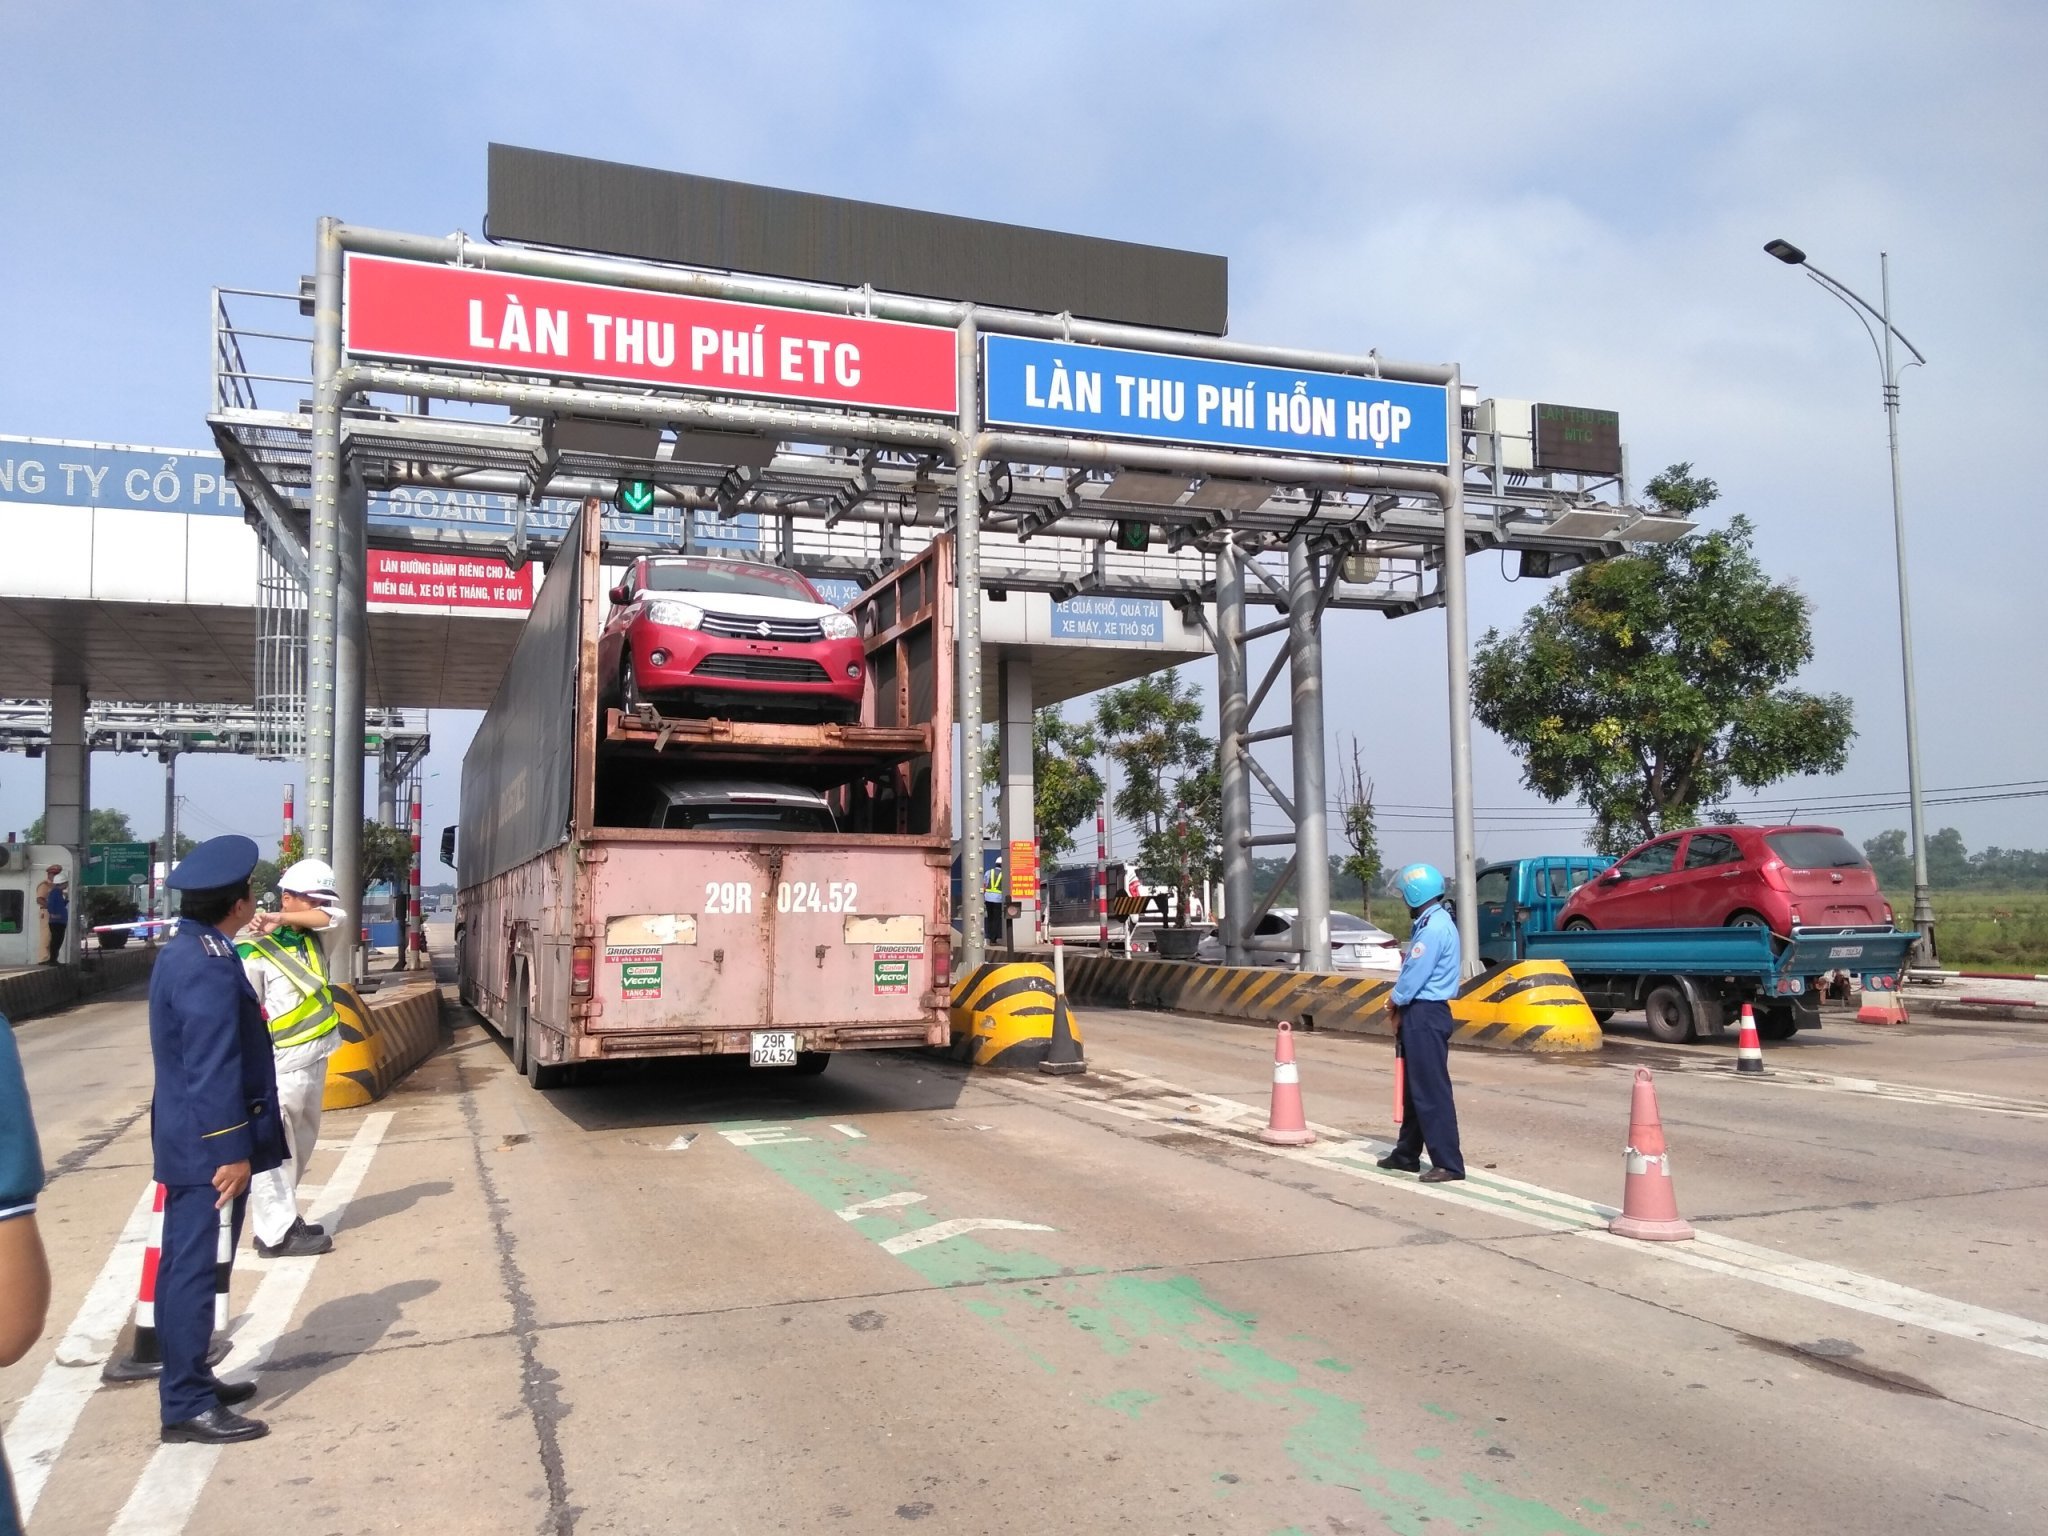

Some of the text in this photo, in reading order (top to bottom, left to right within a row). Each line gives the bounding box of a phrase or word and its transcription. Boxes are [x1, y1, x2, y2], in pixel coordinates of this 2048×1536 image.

[469, 294, 861, 388] LÀN THU PHÍ ETC
[1025, 359, 1411, 449] LÀN THU PHÍ HỖN HỢP
[59, 463, 109, 498] TY
[125, 456, 181, 503] CỔ
[193, 473, 243, 508] PH
[380, 557, 398, 573] LÀN
[400, 558, 431, 576] ĐƯỜNG
[432, 560, 457, 577] DÀNH
[458, 562, 485, 578] RIÊNG
[486, 565, 503, 579] CHO
[399, 581, 417, 598] GIÁ,
[419, 583, 432, 597] XE
[433, 582, 445, 598] CÓ
[446, 582, 458, 599] VÉ
[459, 584, 490, 601] THÁNG,
[842, 585, 858, 600] XE
[1056, 600, 1069, 613] XE
[1071, 600, 1093, 615] QUÁ
[1120, 602, 1141, 617] QUÁ
[1062, 620, 1075, 633] XE
[1078, 618, 1101, 636] MÁY,
[1104, 622, 1117, 635] XE
[1119, 621, 1139, 635] THÔ
[704, 881, 858, 914] 29R 024.52
[762, 1034, 786, 1048] 29R
[753, 1049, 794, 1064] 024.52
